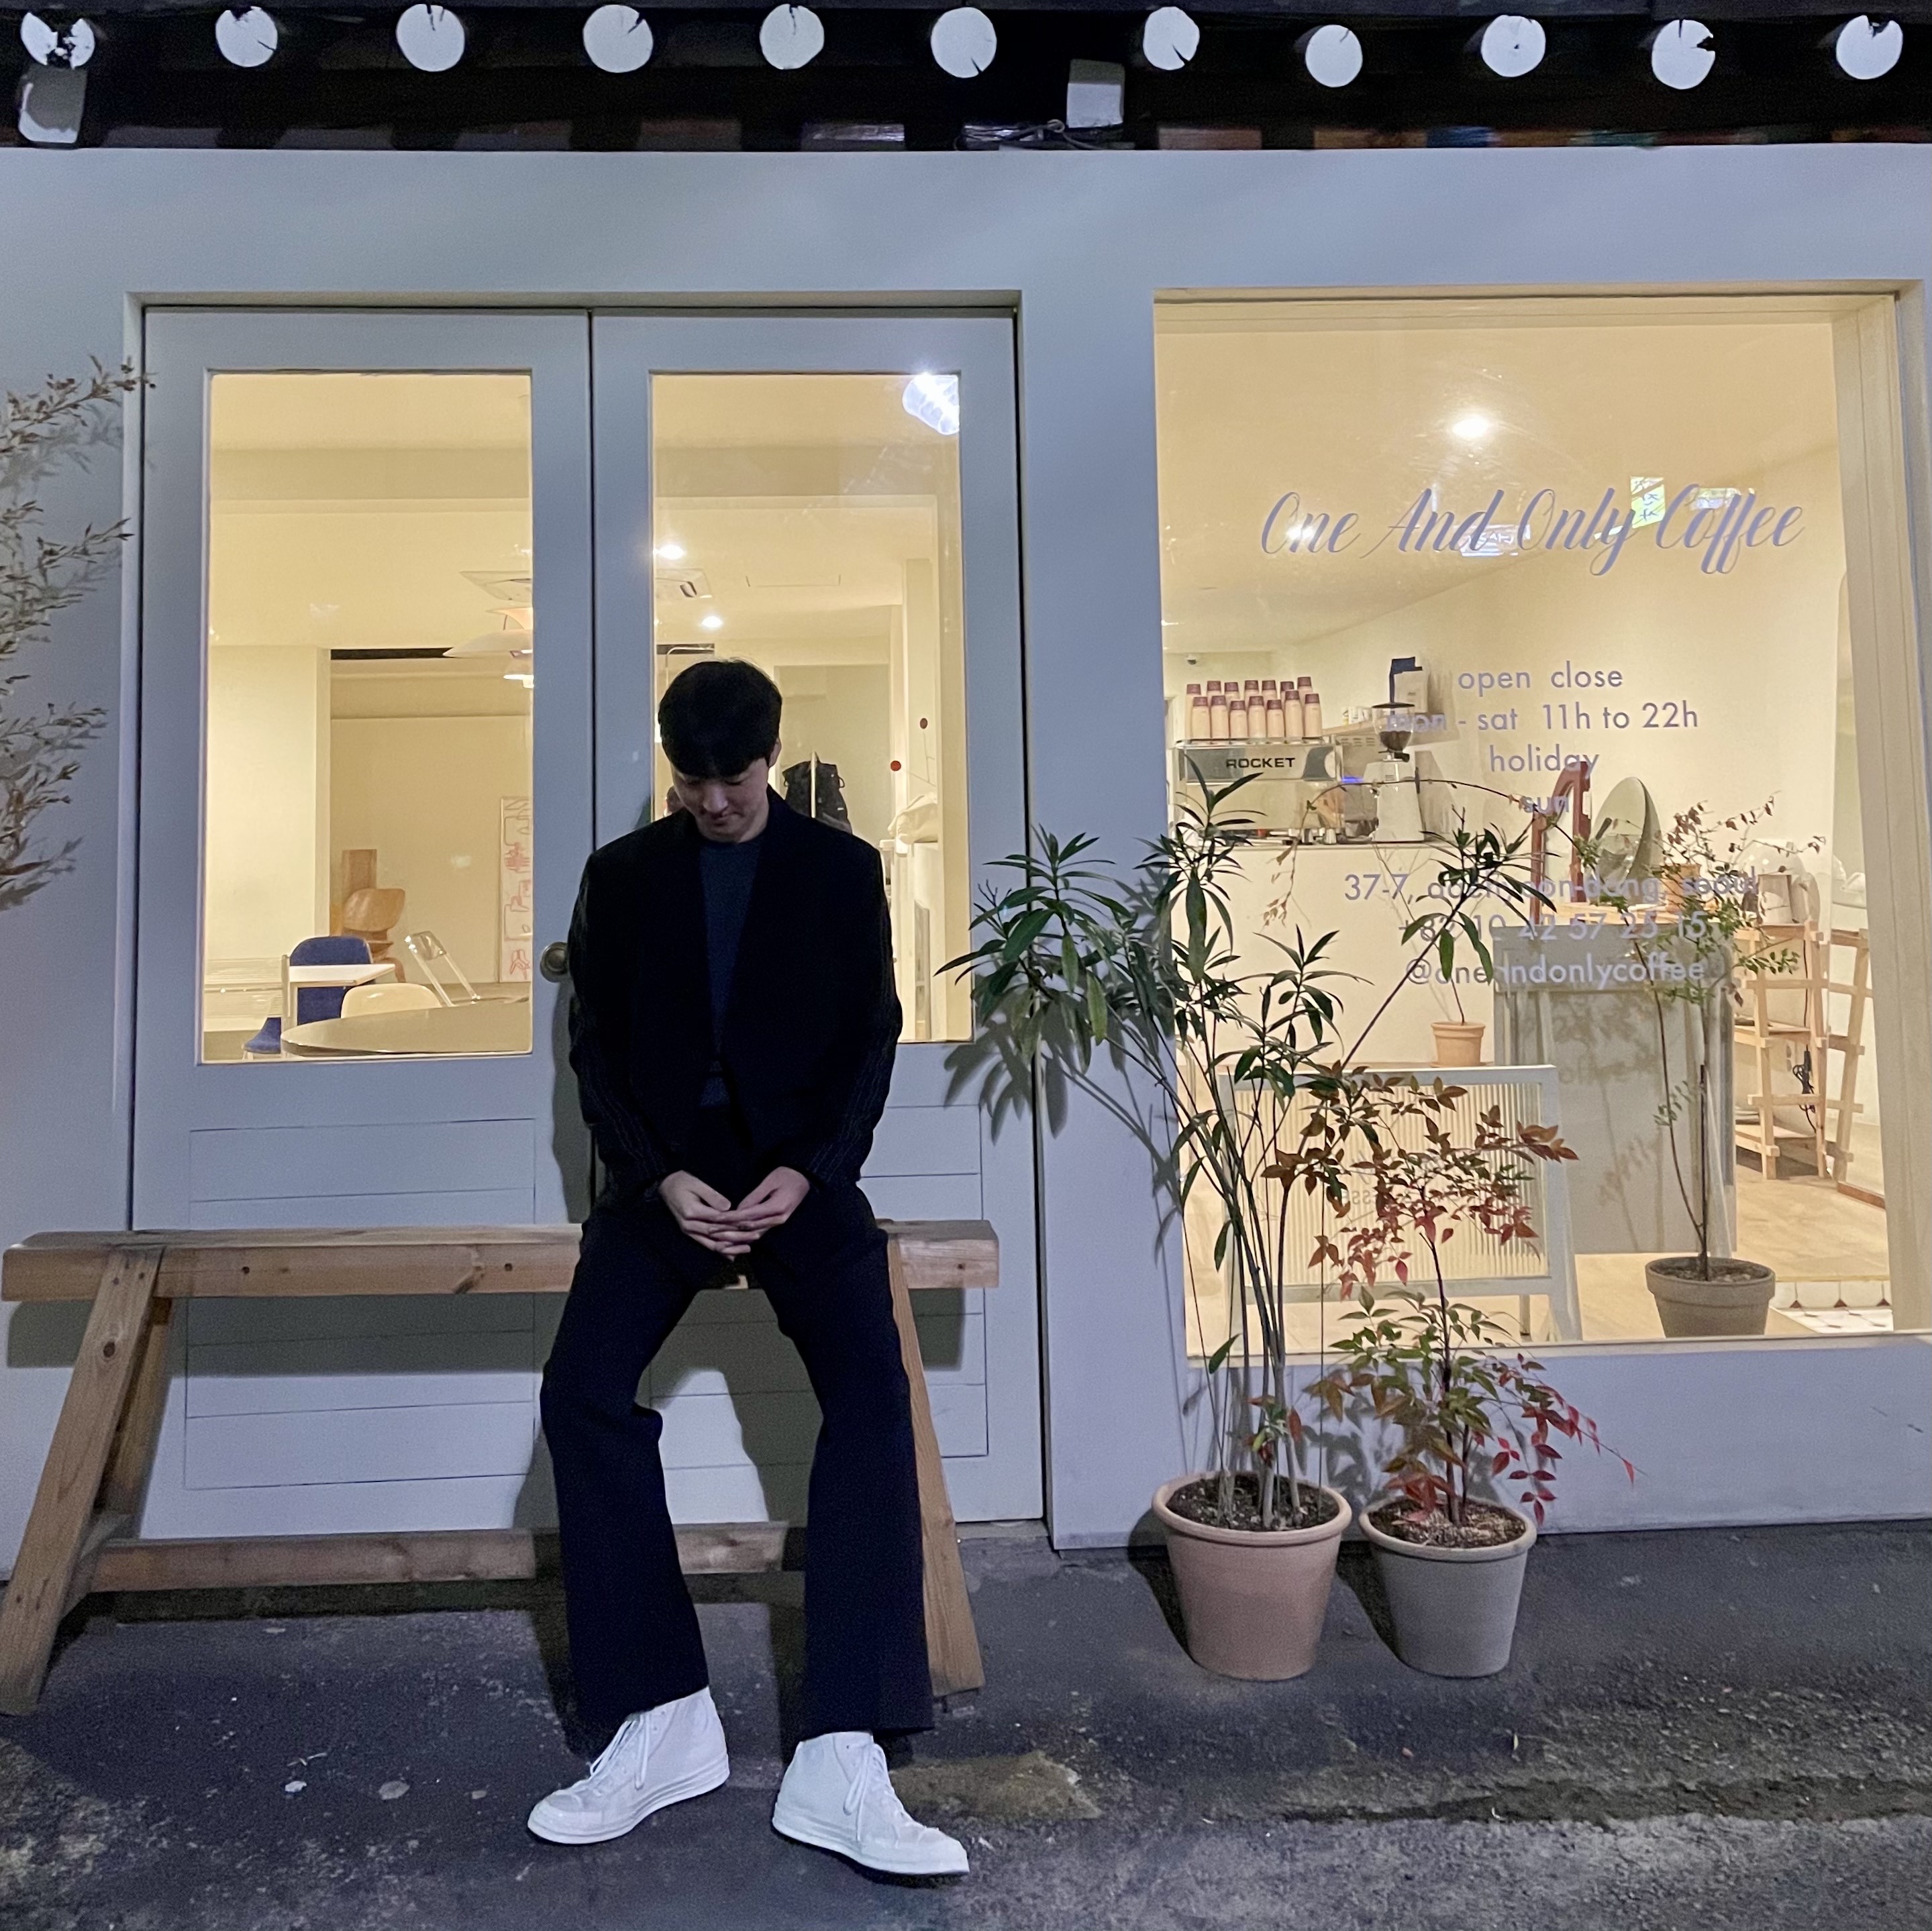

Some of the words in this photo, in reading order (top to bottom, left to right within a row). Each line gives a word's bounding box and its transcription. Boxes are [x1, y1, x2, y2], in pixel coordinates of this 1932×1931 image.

[1261, 492, 1361, 554] One
[1360, 488, 1505, 559] And
[1518, 488, 1637, 576] Only
[1656, 484, 1806, 575] Coffee
[1458, 671, 1531, 697] open
[1551, 660, 1623, 688] close
[1478, 709, 1518, 731] sat
[1543, 701, 1591, 729] 11h
[1603, 707, 1630, 729] to
[1642, 700, 1698, 728] 22h
[1225, 758, 1296, 769] ROCKET
[1489, 743, 1599, 781] holiday
[1520, 796, 1570, 815] sun
[1683, 866, 1758, 896] seoul
[1399, 915, 1460, 941] +8
[1518, 912, 1558, 941] 42
[1568, 912, 1607, 941] 57
[1620, 910, 1659, 939] 25
